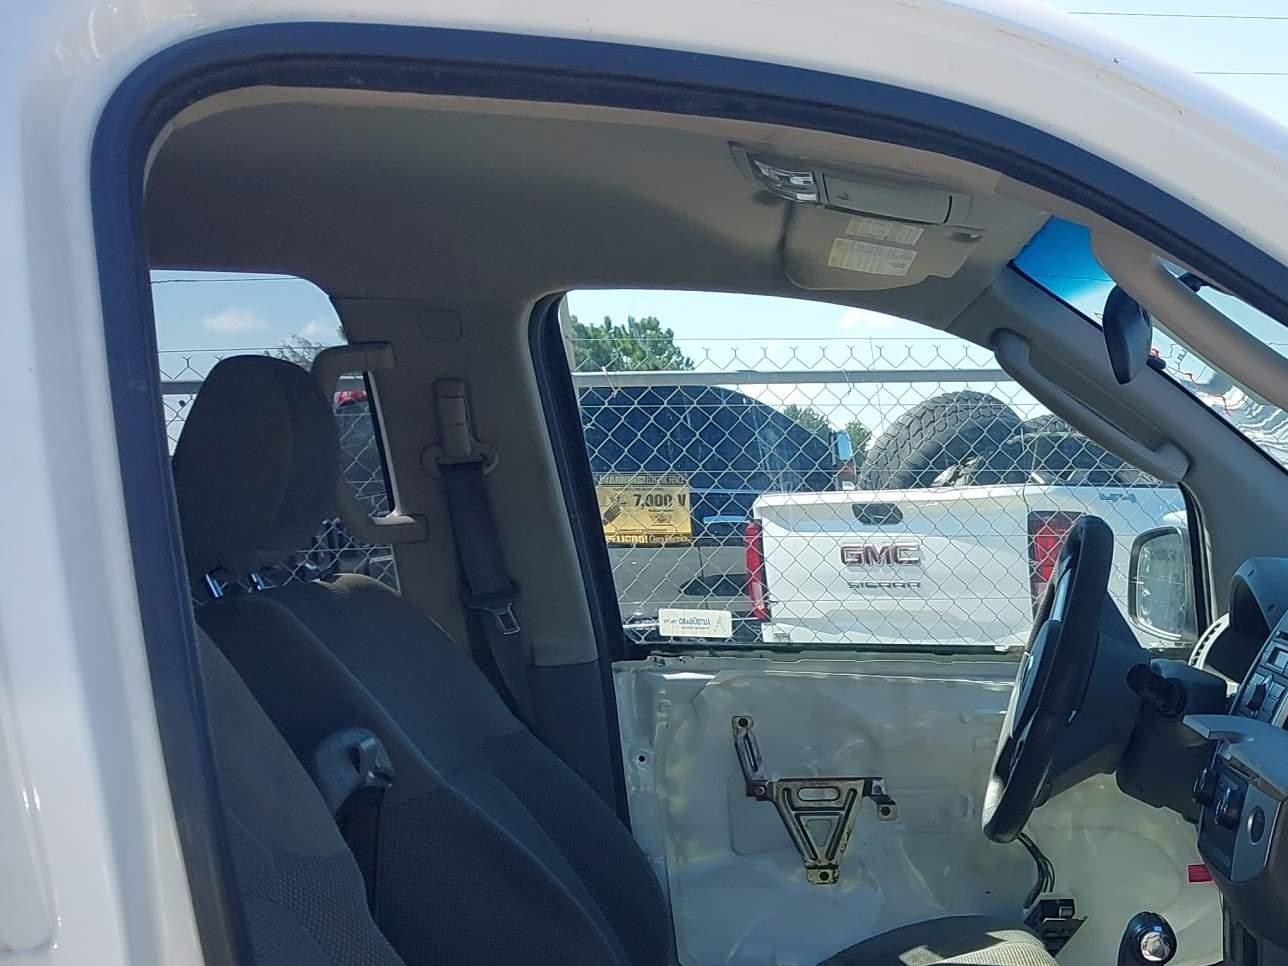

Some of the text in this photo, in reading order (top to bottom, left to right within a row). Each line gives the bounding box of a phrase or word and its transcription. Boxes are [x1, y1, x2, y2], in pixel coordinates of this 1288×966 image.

[633, 493, 687, 510] 7,000 V
[840, 543, 921, 567] GMC
[847, 581, 921, 589] SIERRA
